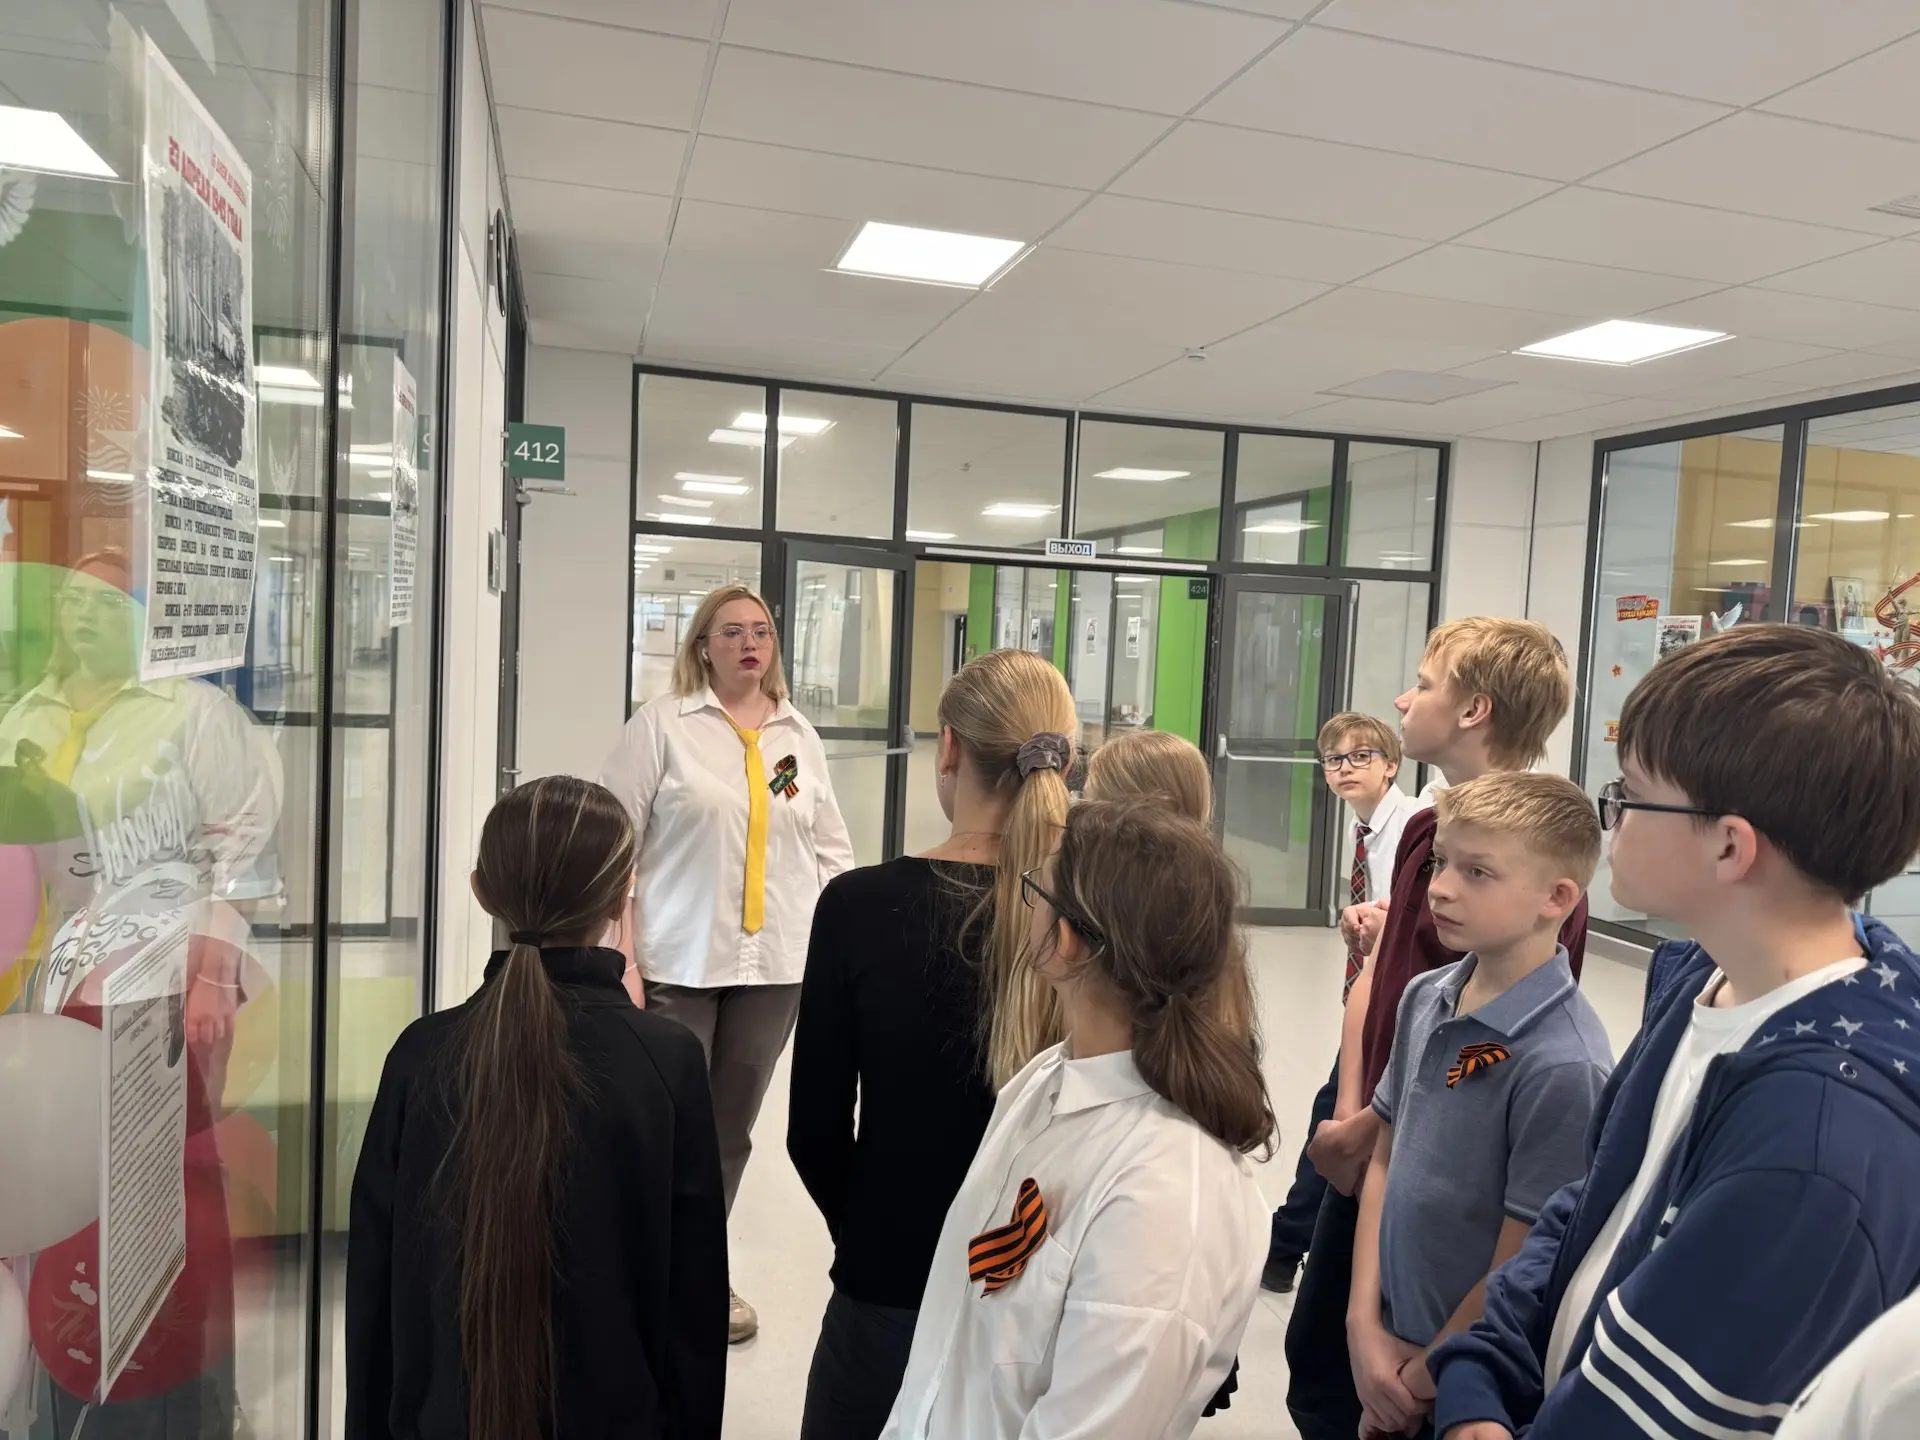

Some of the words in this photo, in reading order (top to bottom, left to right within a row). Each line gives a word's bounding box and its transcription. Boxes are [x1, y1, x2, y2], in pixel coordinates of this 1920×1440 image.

[182, 151, 210, 207] АПРЕЛЯ
[212, 186, 226, 224] 1945
[228, 204, 242, 242] ГОДА
[514, 440, 560, 463] 412
[165, 514, 181, 529] ВОЙСКА
[223, 527, 237, 540] ФРОНТА
[1050, 543, 1090, 555] ВЫХОД
[1190, 585, 1207, 594] 424
[165, 604, 181, 616] ВОЙСКА
[220, 604, 233, 616] ФРОНТА
